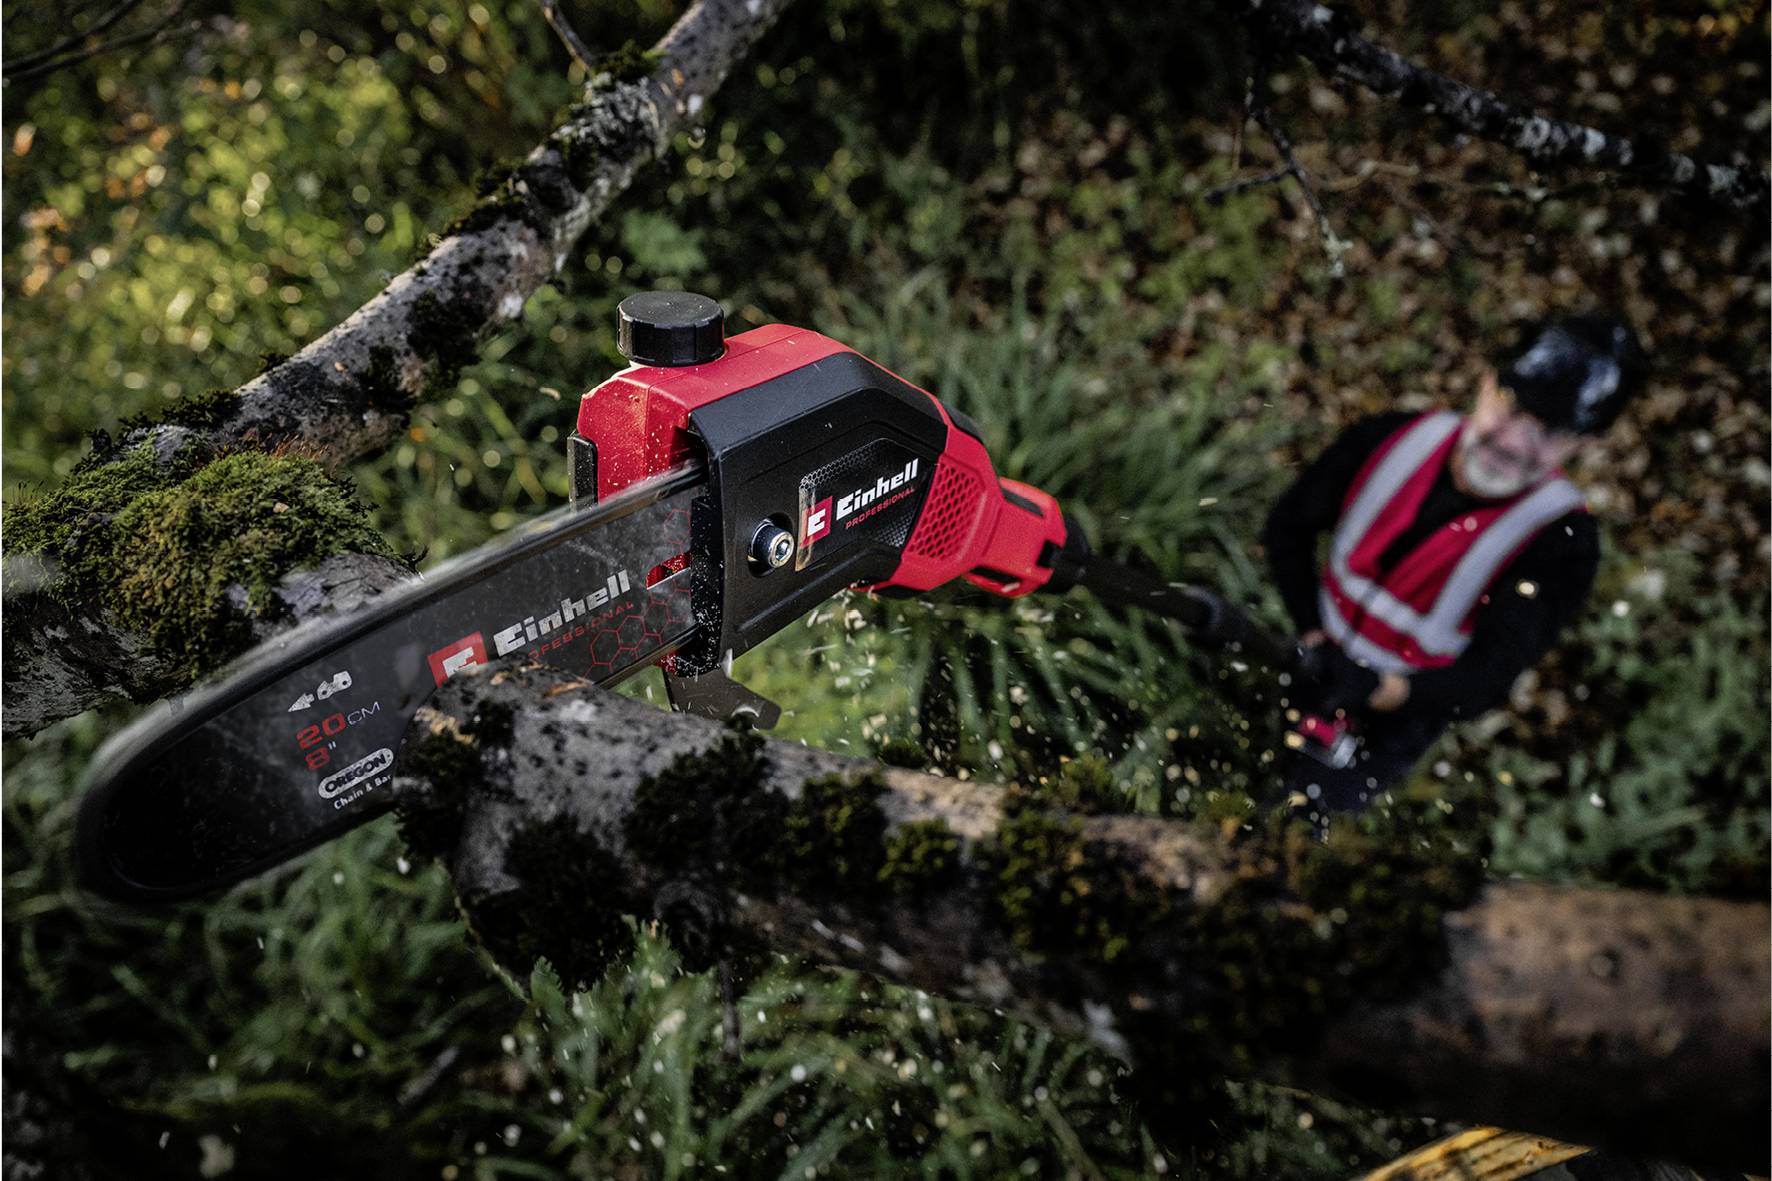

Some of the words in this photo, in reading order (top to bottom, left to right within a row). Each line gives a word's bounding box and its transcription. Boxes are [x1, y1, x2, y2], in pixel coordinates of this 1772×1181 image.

[836, 458, 919, 521] Einhell
[845, 486, 916, 530] PROFESSIONAL
[493, 569, 631, 656] Einhell
[528, 601, 634, 660] OFESSIONAL
[325, 754, 386, 792] OREGON
[334, 789, 364, 809] Chain
[366, 782, 373, 792] &
[374, 775, 392, 787] Bar
